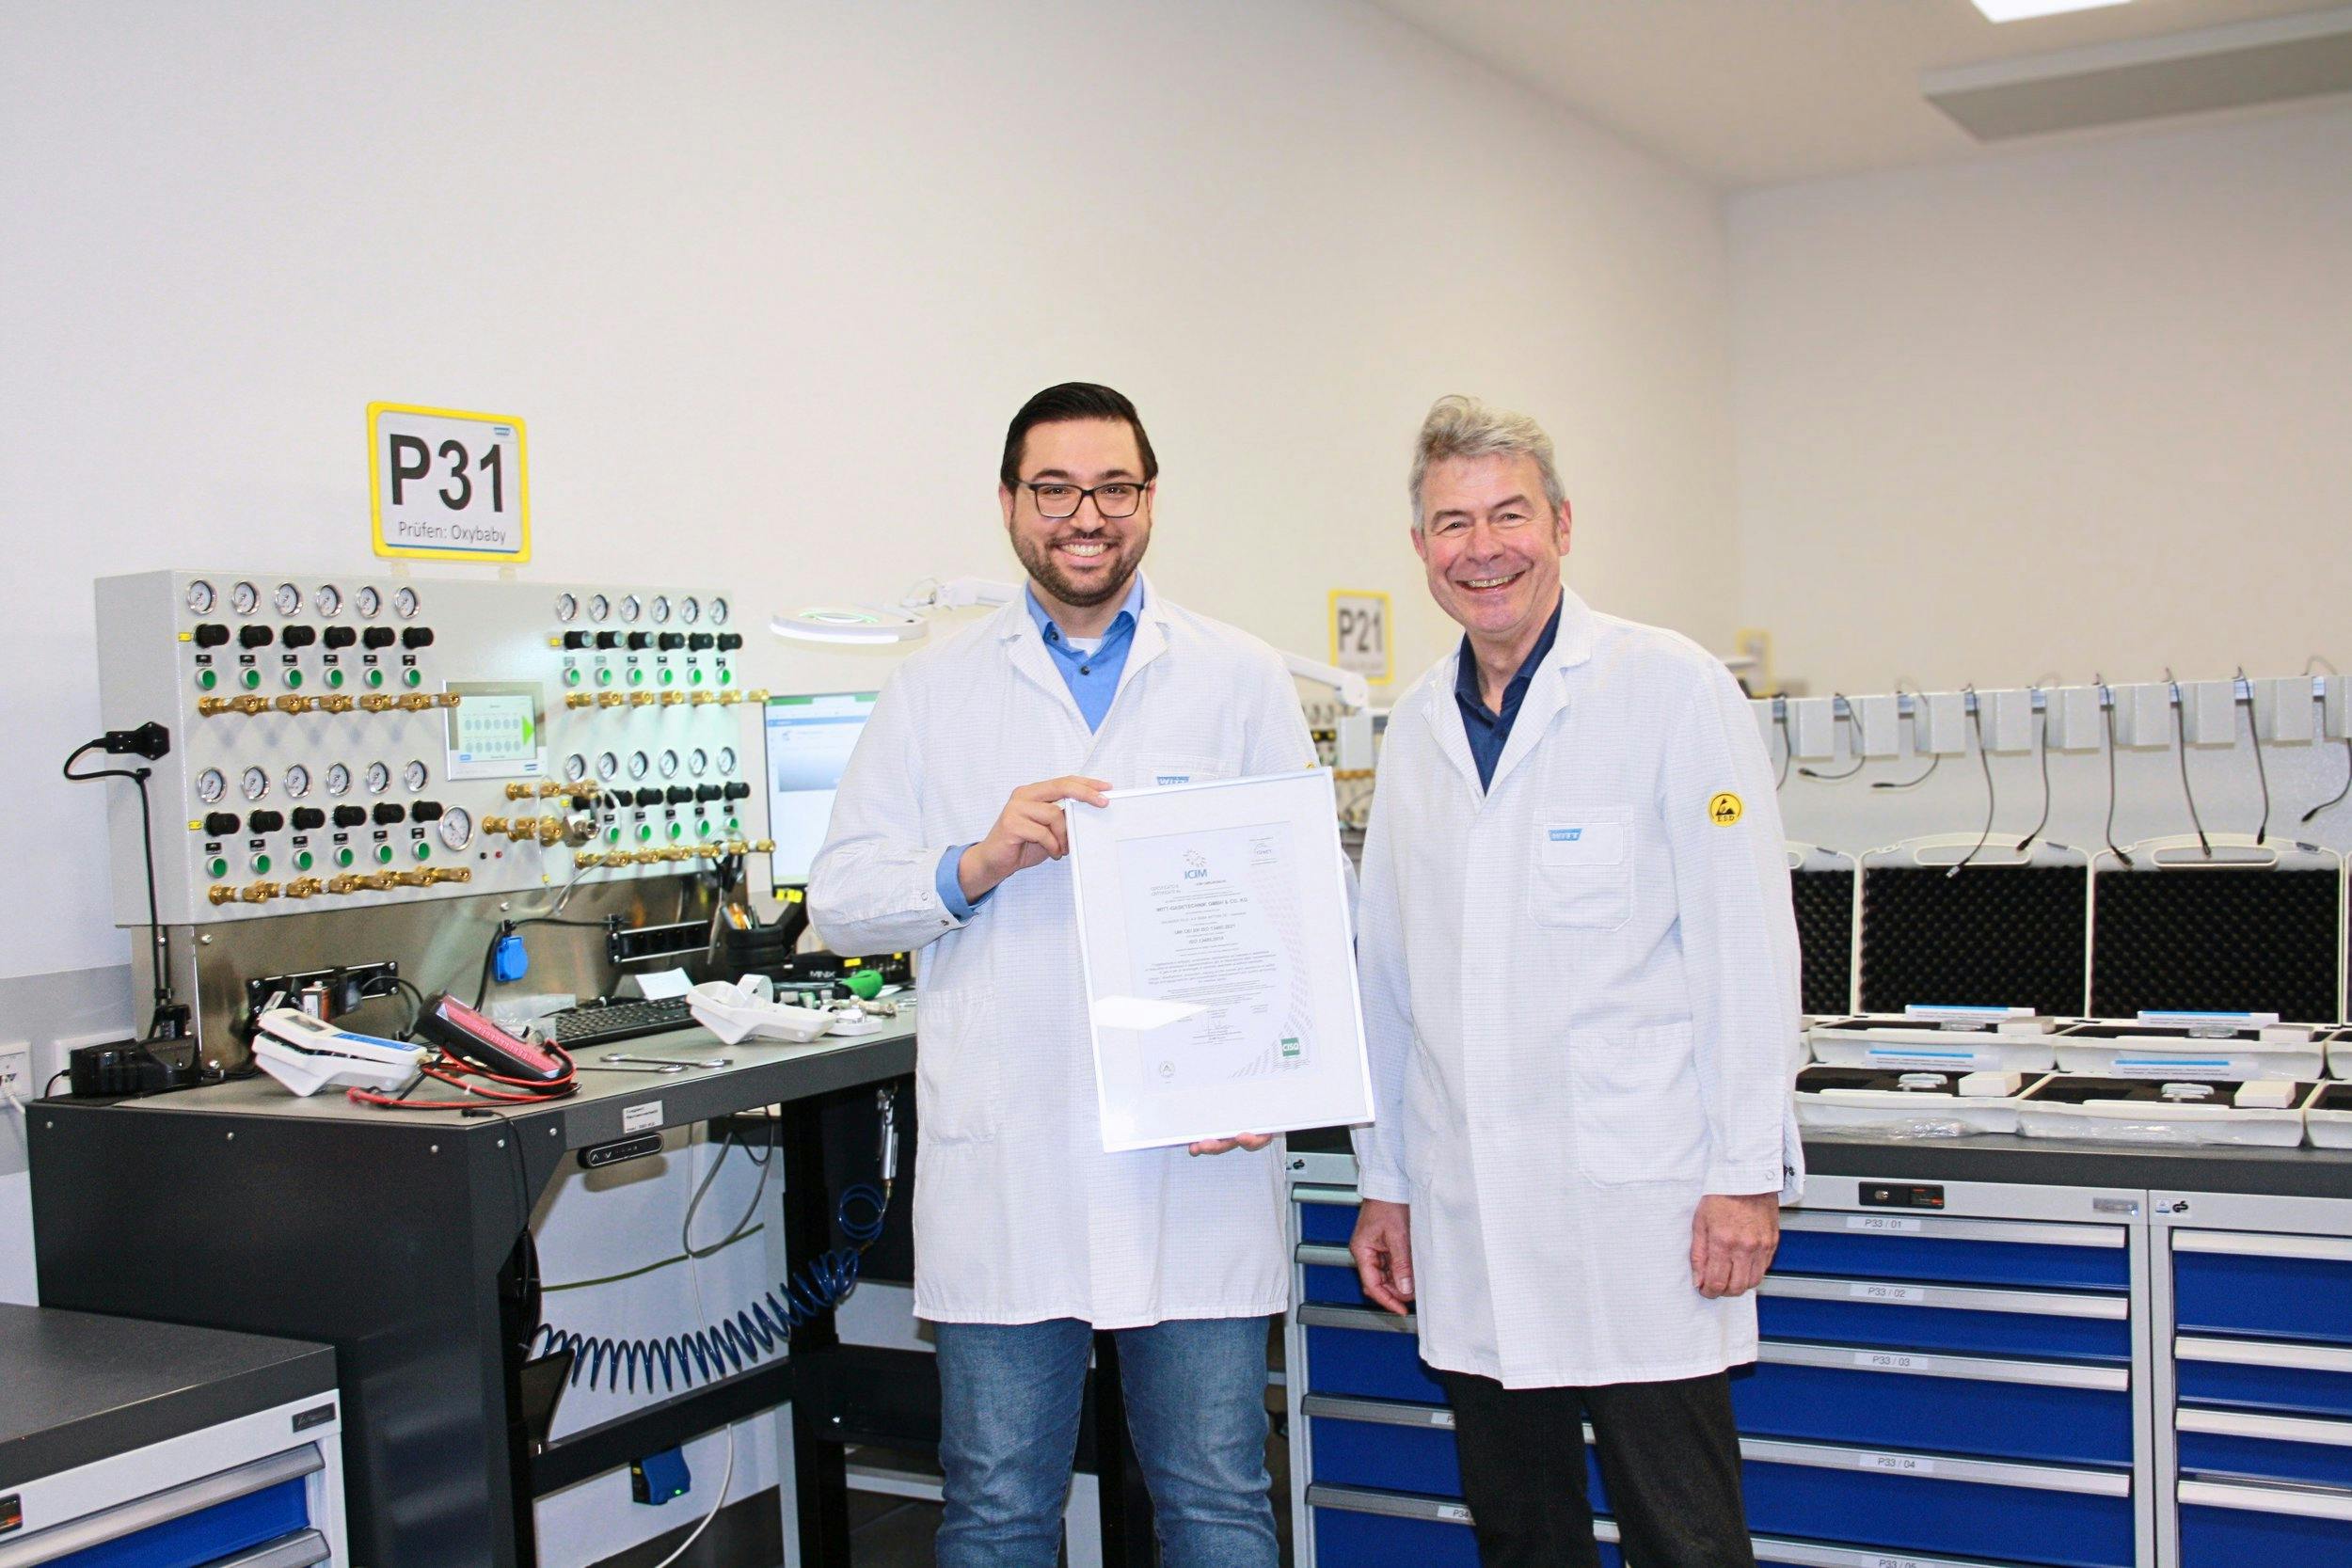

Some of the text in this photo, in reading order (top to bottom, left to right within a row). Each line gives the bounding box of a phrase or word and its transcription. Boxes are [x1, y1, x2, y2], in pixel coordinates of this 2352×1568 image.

[389, 434, 503, 513] P31
[399, 521, 506, 545] Prüfen: Oxybaby
[1338, 609, 1383, 653] P21
[1865, 1219, 1883, 1227] P33
[1891, 1220, 1901, 1228] 01
[1867, 1287, 1886, 1296] P33
[1894, 1289, 1906, 1298] 02
[1873, 1355, 1891, 1365] P33
[1899, 1357, 1910, 1367] 03
[1878, 1457, 1896, 1466] P33
[1904, 1460, 1915, 1468] 04
